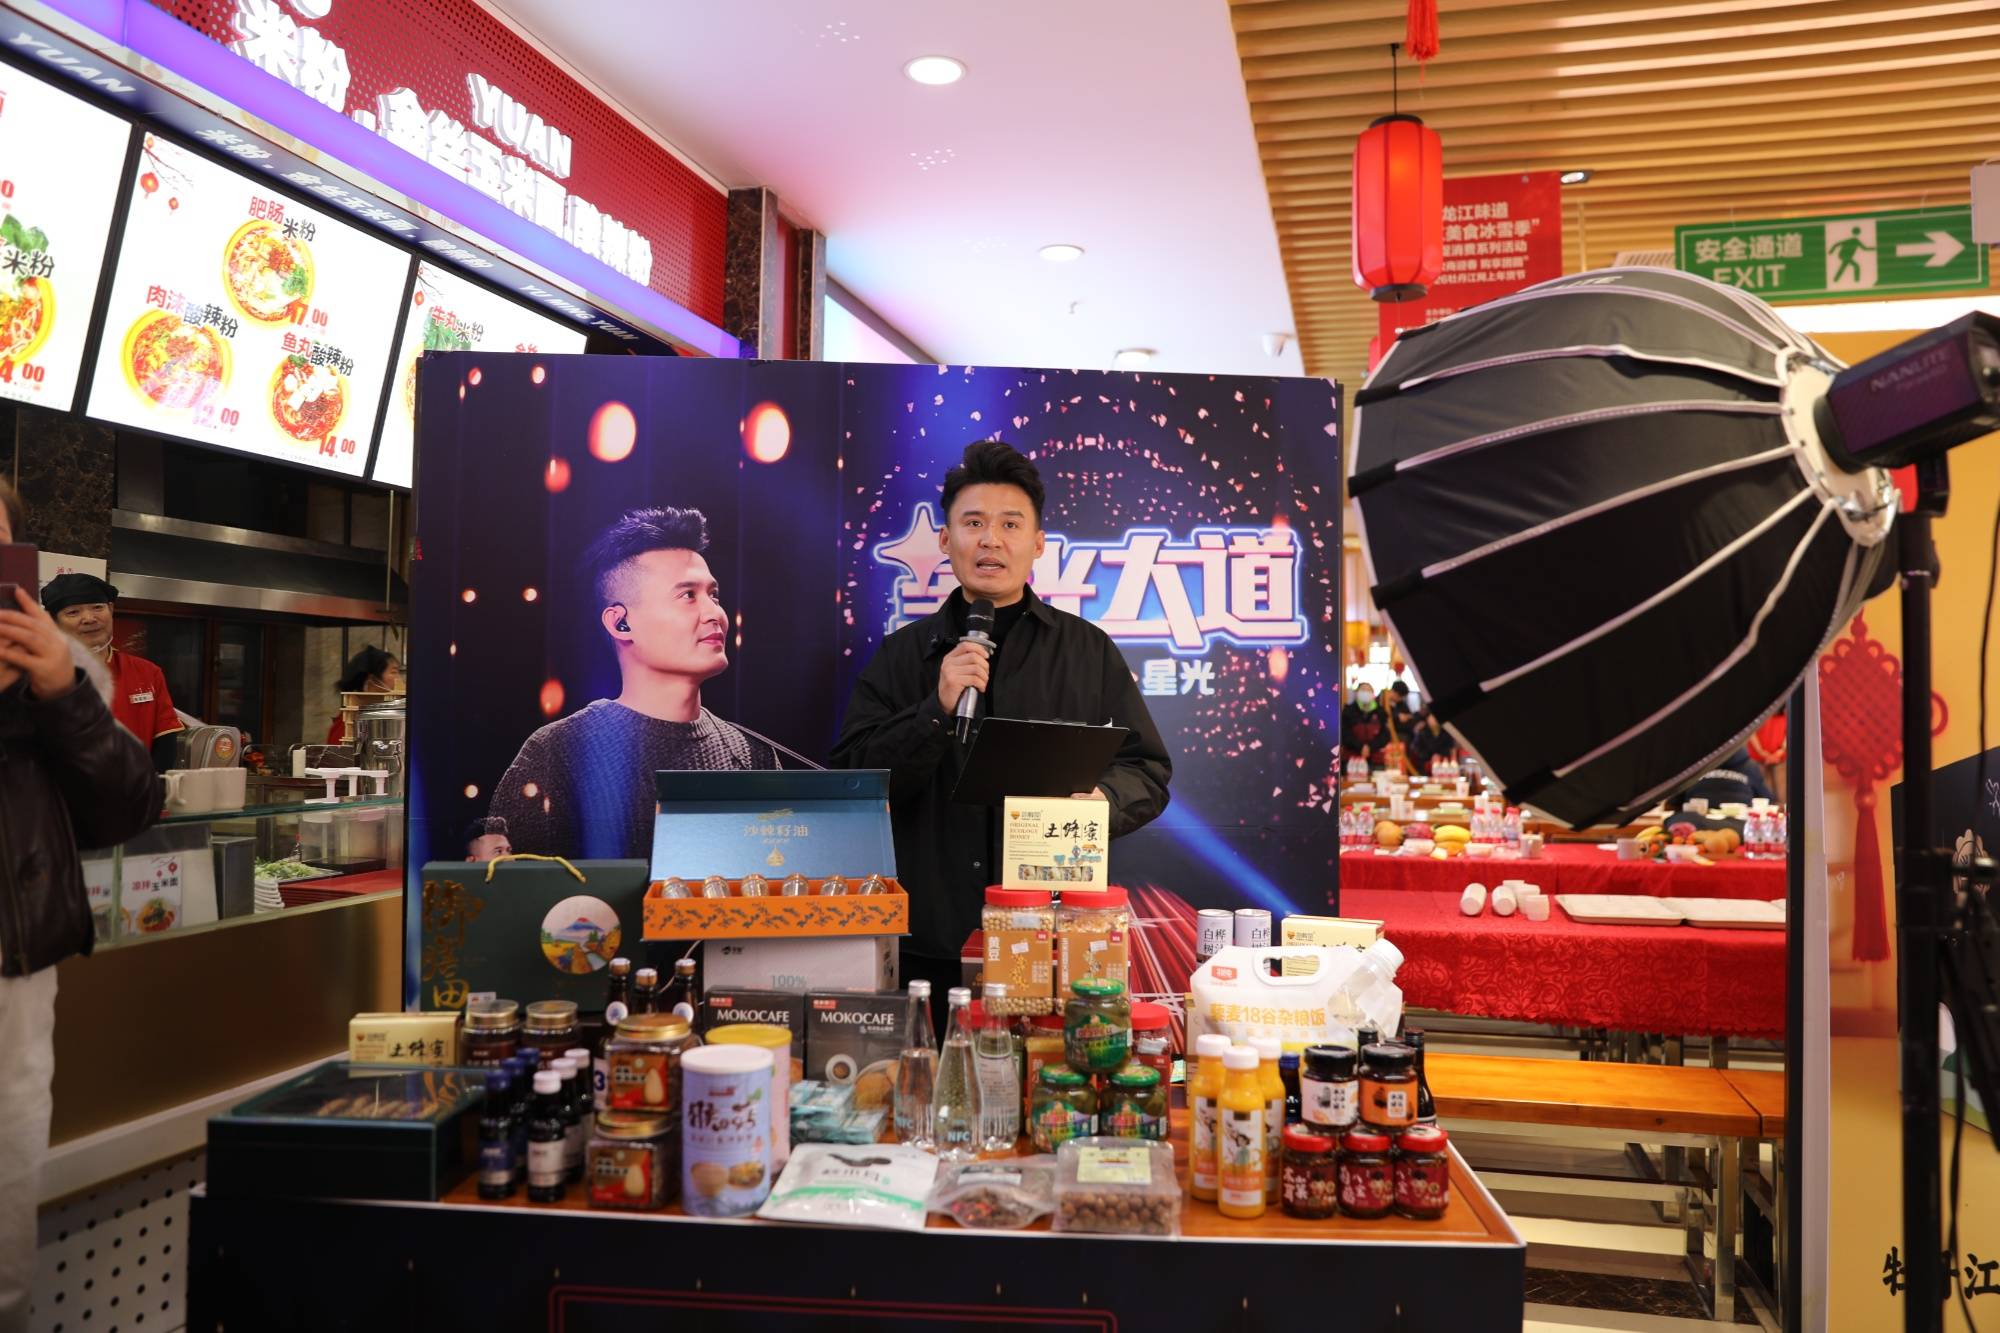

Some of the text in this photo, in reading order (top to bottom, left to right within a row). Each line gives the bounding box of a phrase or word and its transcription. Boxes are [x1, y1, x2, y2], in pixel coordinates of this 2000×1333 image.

[8, 32, 136, 93] YUAN
[467, 72, 573, 179] YUAN
[1695, 233, 1804, 264] 安全通道
[2, 250, 55, 278] 米粉
[1712, 264, 1786, 290] EXIT
[544, 299, 596, 321] MING
[591, 319, 639, 341] YUAN
[1142, 658, 1216, 696] 星光
[1044, 819, 1099, 843] 土蜂蜜
[1204, 929, 1226, 940] 白桦
[716, 1009, 790, 1023] MOKOCAFE
[820, 1011, 895, 1026] MOKOCAFE
[947, 1130, 970, 1142] NFC
